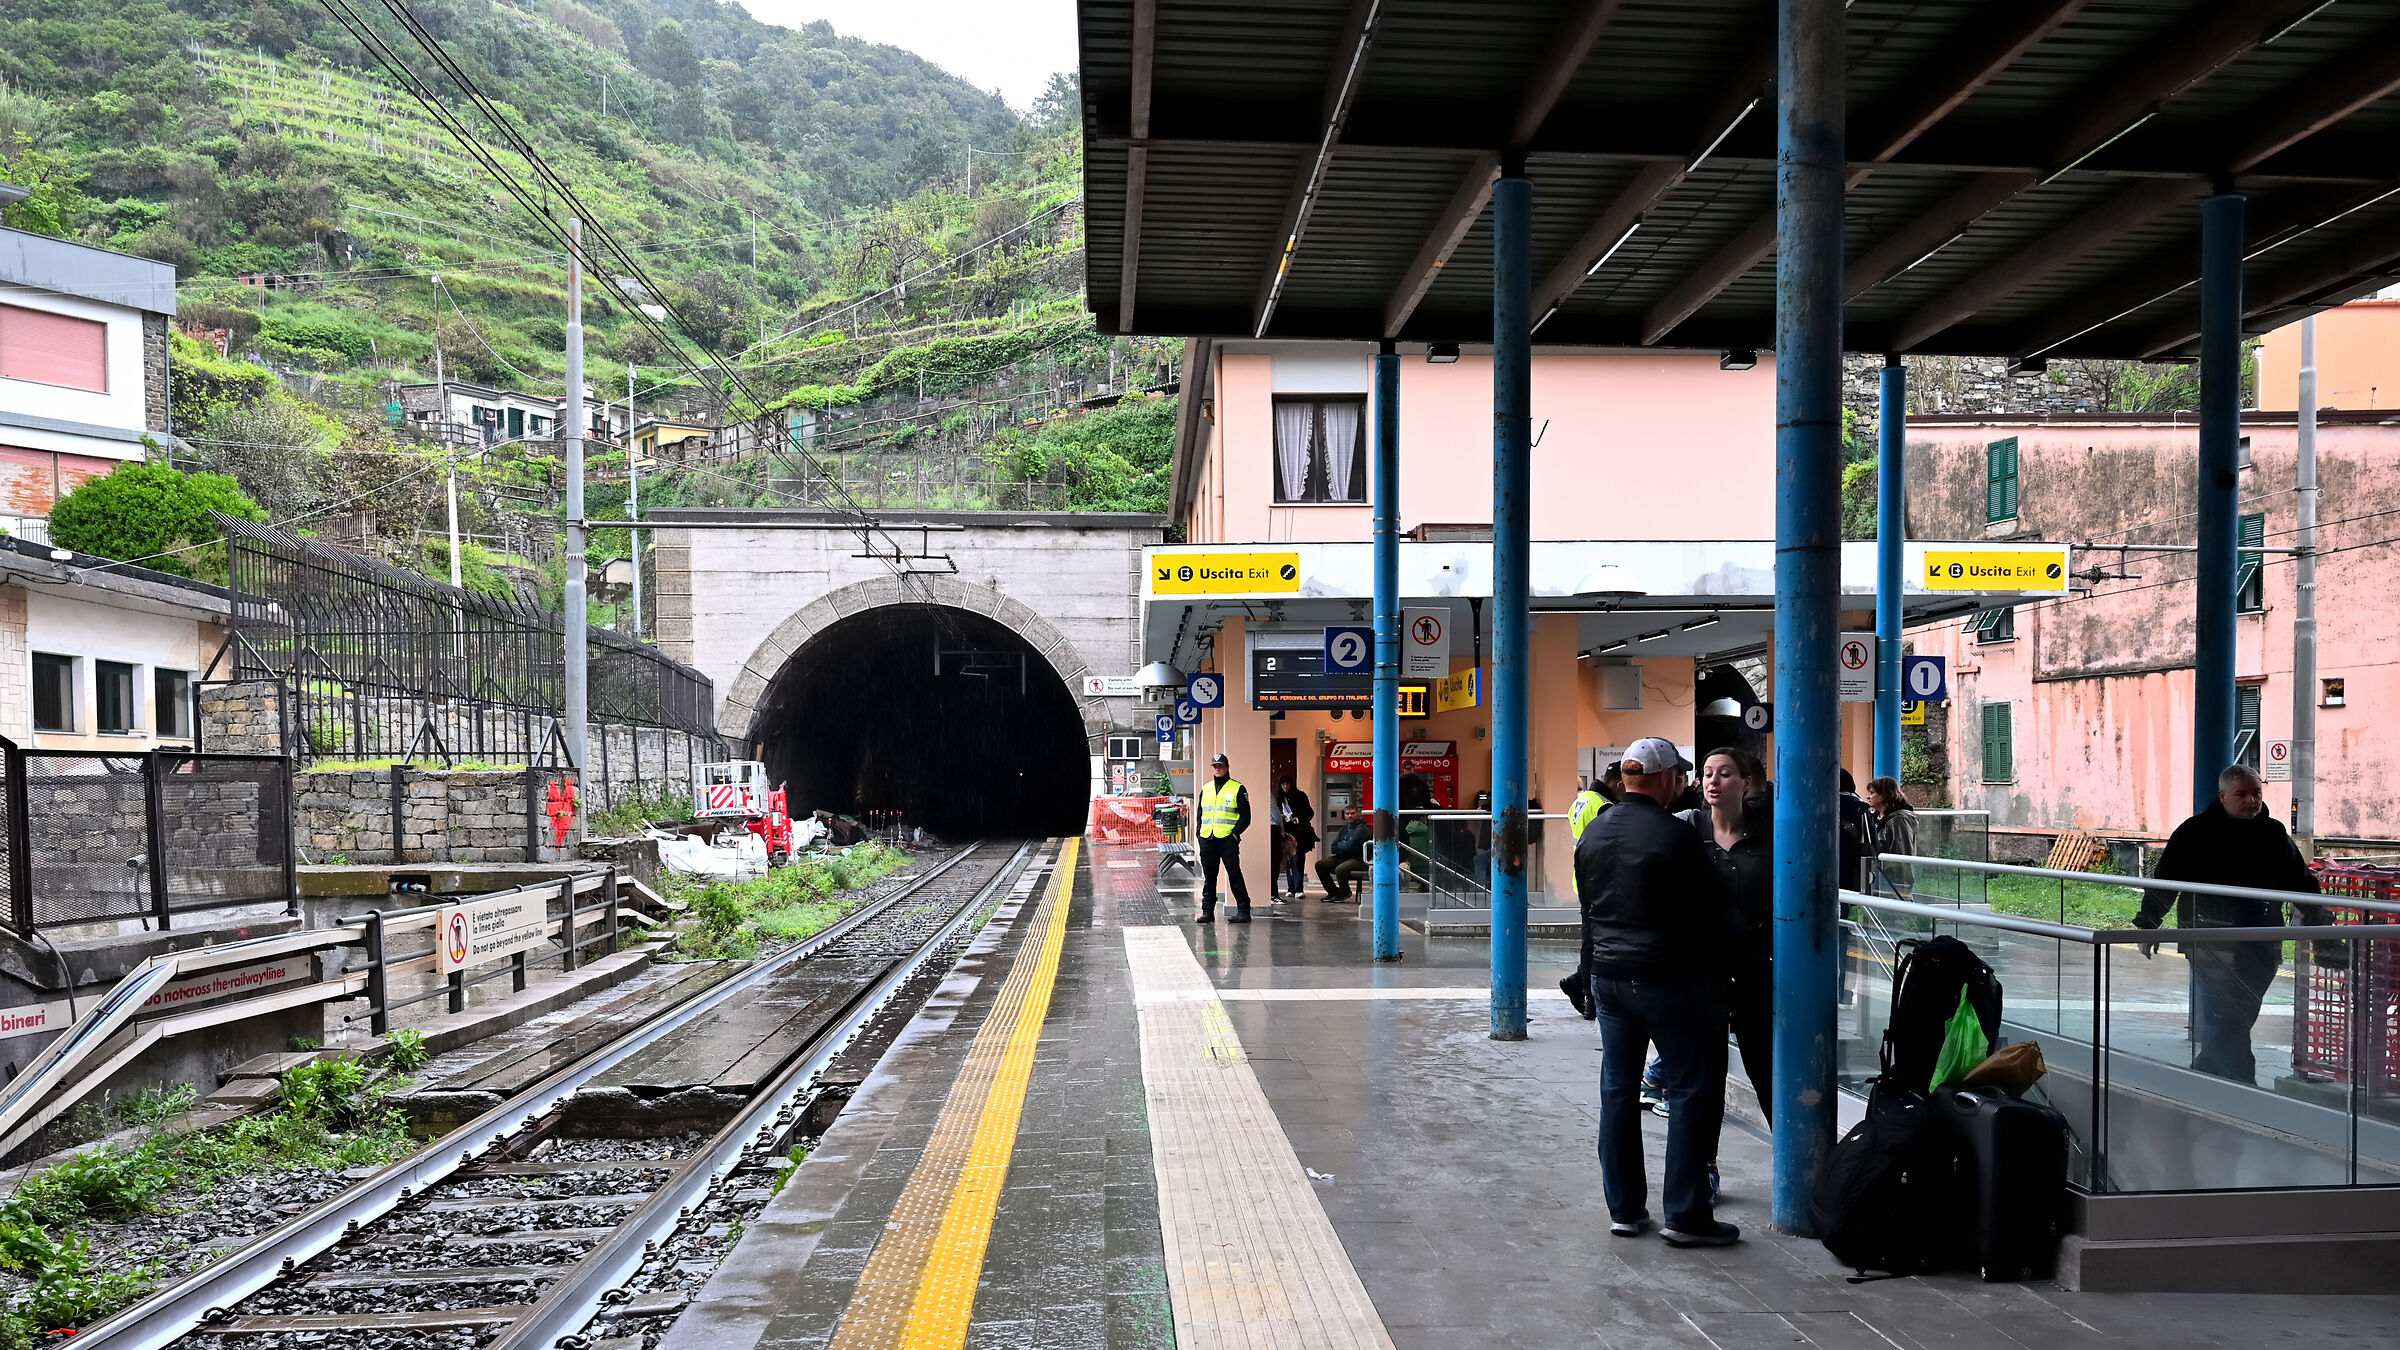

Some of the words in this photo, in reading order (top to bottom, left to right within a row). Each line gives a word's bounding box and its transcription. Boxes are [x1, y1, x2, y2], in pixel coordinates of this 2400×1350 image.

[1200, 568, 1243, 579] Uscita
[1249, 568, 1269, 579] Exit
[1970, 566, 2011, 577] Uscita
[2017, 566, 2036, 577] Exit
[1340, 638, 1357, 661] 2
[1267, 657, 1276, 671] 2
[1920, 667, 1929, 690] 1
[1183, 703, 1193, 718] 2
[477, 911, 493, 922] vietato
[494, 905, 522, 918] oltrepassare
[473, 924, 478, 935] la
[479, 923, 491, 933] linea
[492, 917, 505, 932] gialla
[473, 944, 480, 955] Do
[490, 942, 496, 953] go
[496, 934, 514, 949] beyond
[522, 930, 535, 943] yellow
[535, 928, 543, 937] line
[165, 989, 184, 1003] not
[185, 984, 211, 998] cross
[213, 978, 228, 993] the
[230, 971, 264, 989] railway
[266, 967, 286, 980] lines
[1, 1009, 46, 1032] binari
